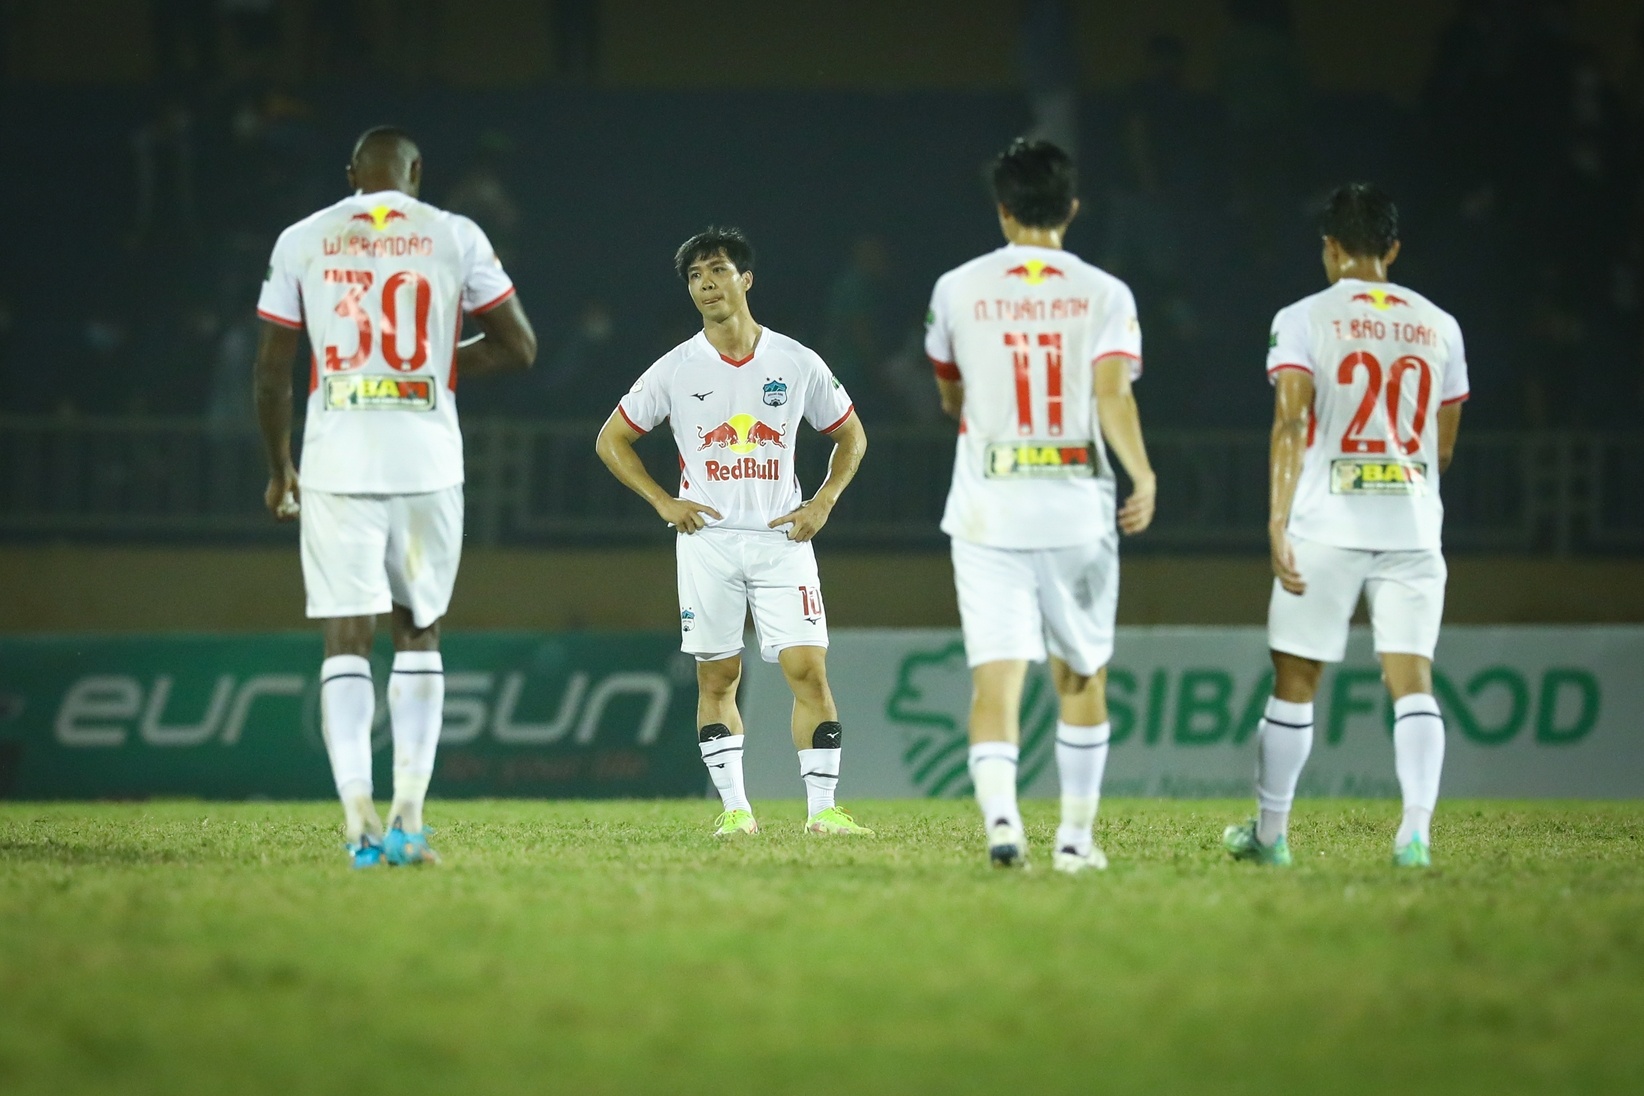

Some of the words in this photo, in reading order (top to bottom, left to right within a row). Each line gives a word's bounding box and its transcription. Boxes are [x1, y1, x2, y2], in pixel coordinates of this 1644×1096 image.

[324, 269, 432, 373] 30
[1003, 332, 1064, 437] 11
[1337, 350, 1433, 456] 20
[798, 585, 823, 616] 10
